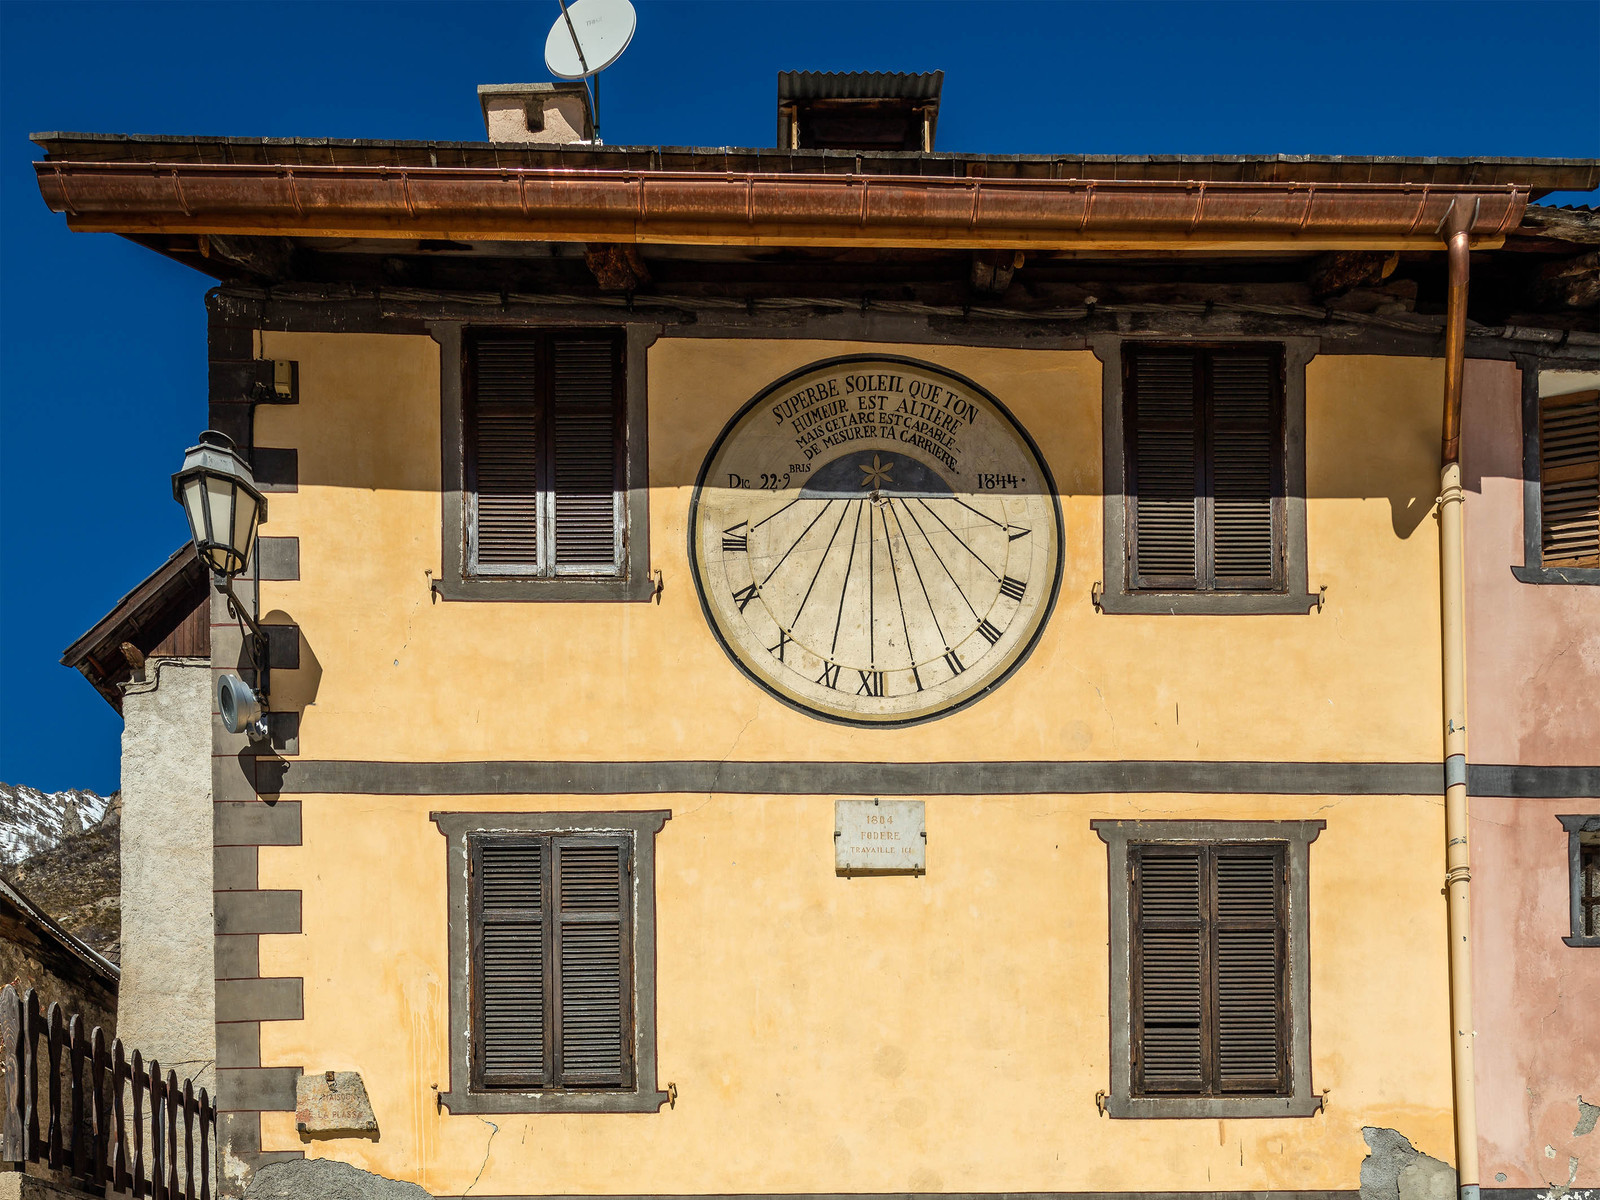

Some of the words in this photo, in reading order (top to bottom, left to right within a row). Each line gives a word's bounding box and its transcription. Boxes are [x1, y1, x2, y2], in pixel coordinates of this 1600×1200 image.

[772, 378, 839, 426] SUPERBE
[845, 374, 904, 395] SOLEIL
[908, 380, 943, 404] QUE
[943, 391, 979, 425] TON
[791, 399, 849, 434] HUMEUR
[857, 394, 889, 411] EST
[894, 398, 963, 435] ALTIERE
[795, 424, 825, 449] MAIS
[878, 412, 904, 426] EST
[903, 416, 956, 451] CAPABLE
[803, 443, 822, 461] DE
[821, 425, 877, 449] MESURER
[880, 425, 897, 440] TA
[767, 628, 793, 662] X
[815, 660, 842, 690] XI
[856, 670, 885, 697] XII
[850, 846, 896, 854] TRAVAILLE
